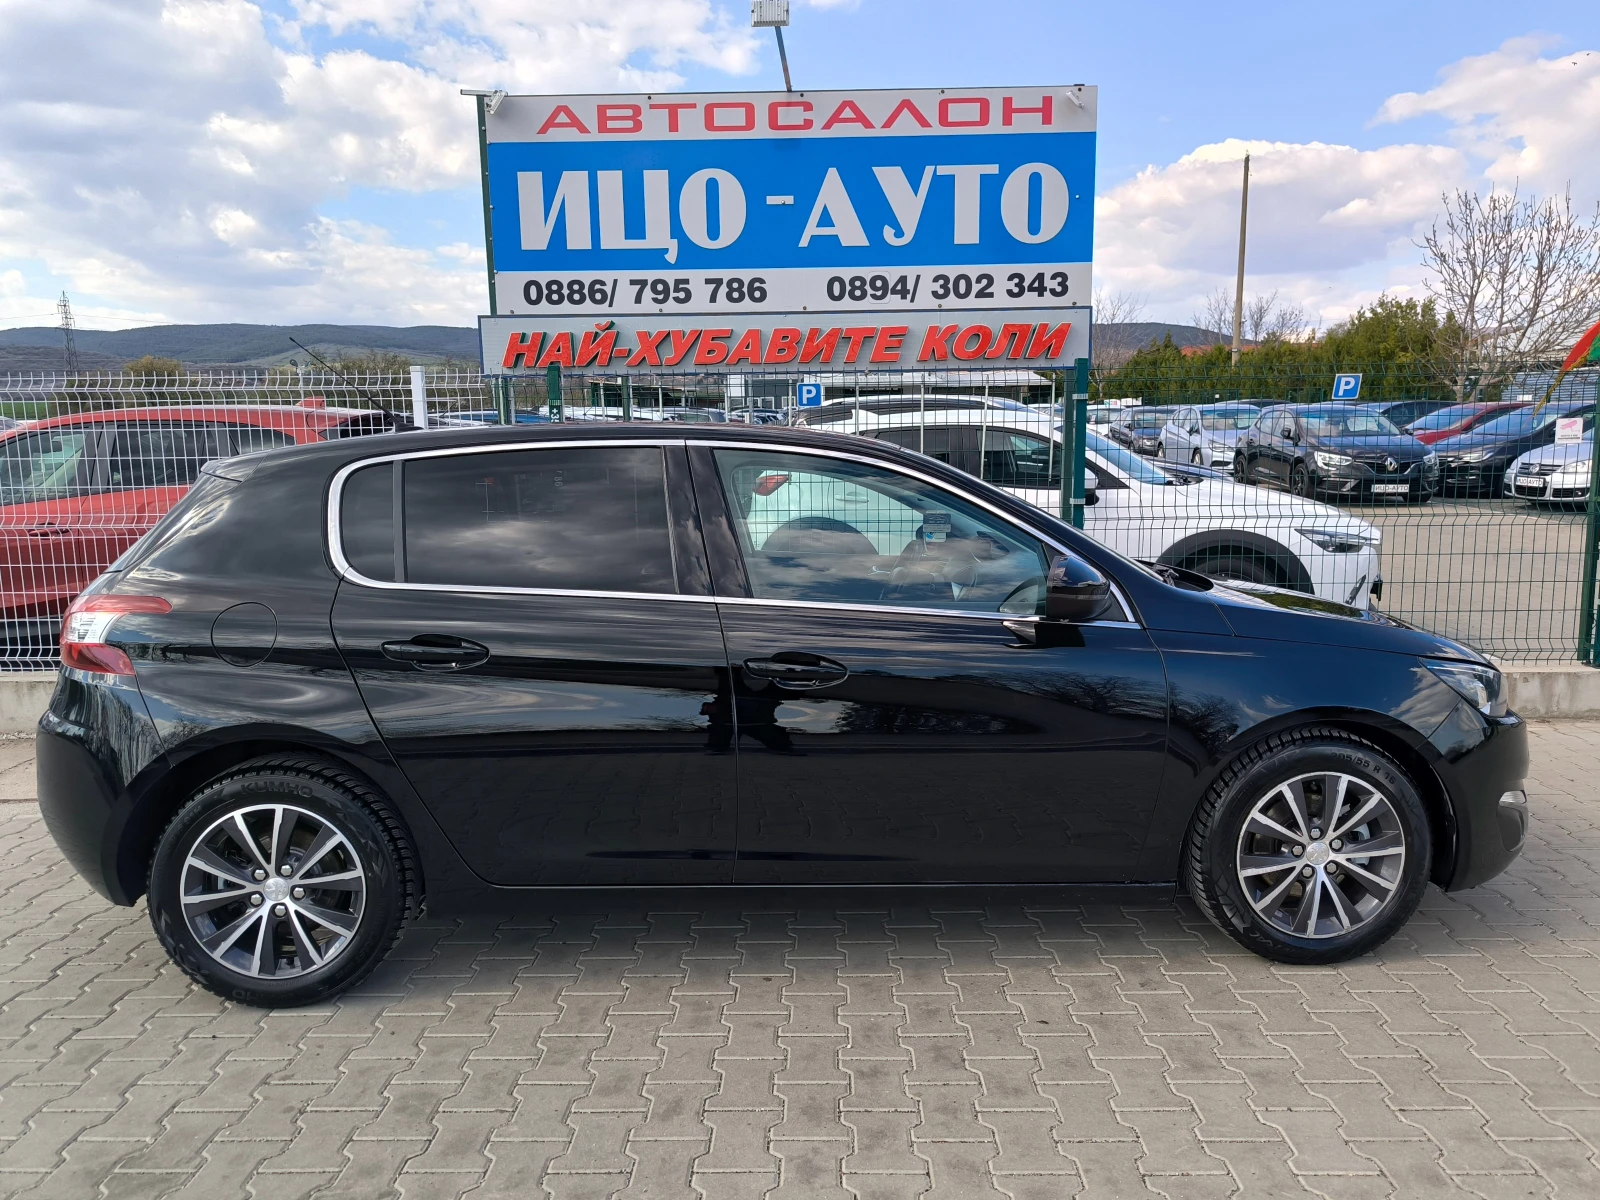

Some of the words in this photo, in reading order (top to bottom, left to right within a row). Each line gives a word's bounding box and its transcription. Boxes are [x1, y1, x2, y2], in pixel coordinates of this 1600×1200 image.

[536, 96, 1052, 134] АВТОСАЛОН
[522, 279, 618, 308] 0886/
[629, 278, 693, 304] 795
[704, 277, 768, 303] 786
[826, 275, 921, 304] 0894/
[931, 274, 995, 300] 302
[1005, 272, 1069, 298] 343
[501, 320, 908, 368] НАЙ-ХУБАВИТЕ
[917, 322, 1073, 363] КОЛИ
[802, 385, 817, 405] P
[1338, 377, 1355, 397] P
[1372, 764, 1382, 774] R
[240, 780, 313, 798] KUMHO
